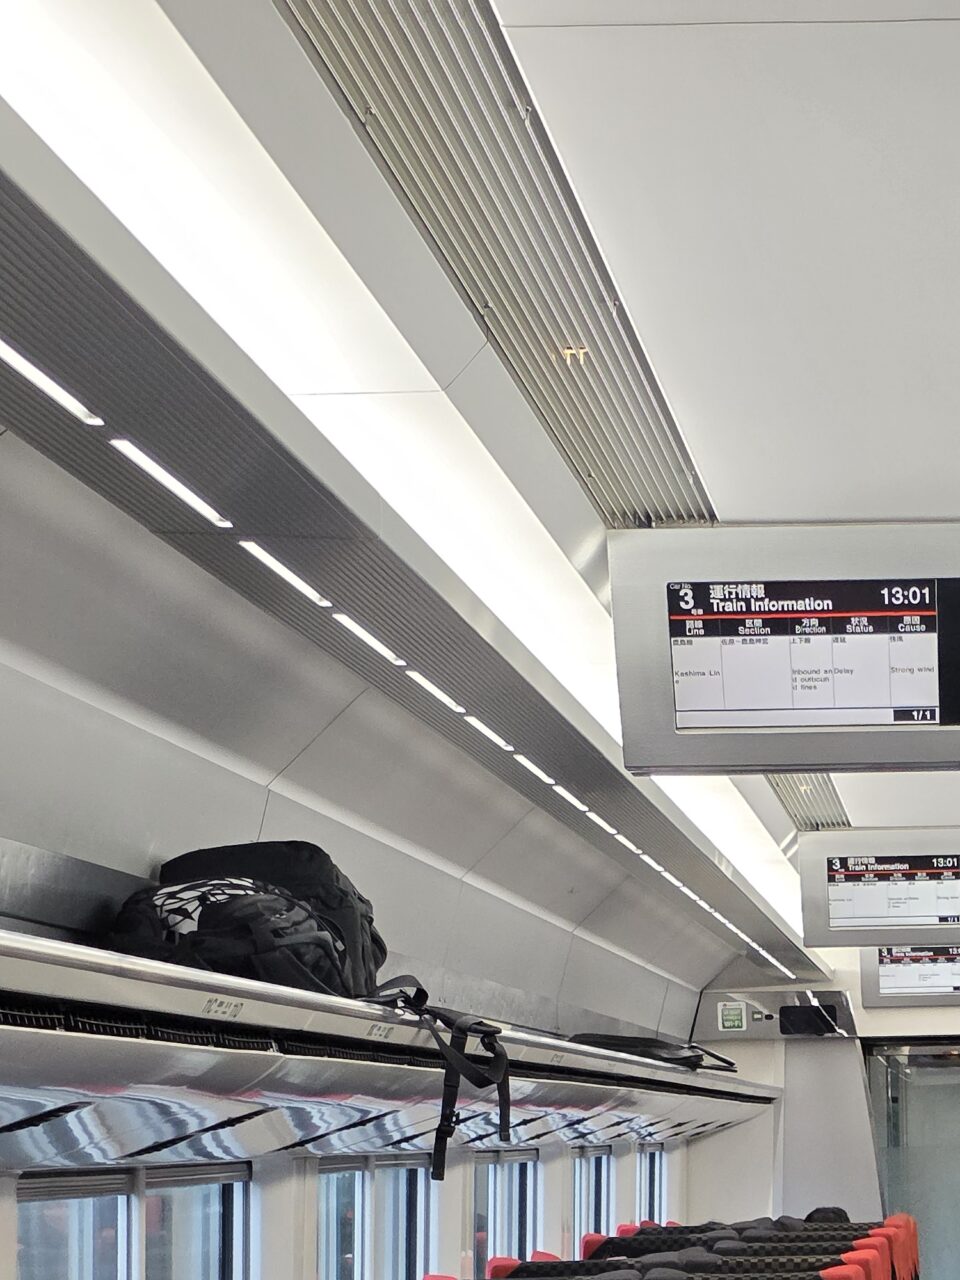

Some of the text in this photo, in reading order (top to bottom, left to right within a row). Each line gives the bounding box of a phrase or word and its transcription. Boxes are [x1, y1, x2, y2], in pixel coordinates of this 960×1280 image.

[709, 584, 765, 599] 運行情報
[880, 587, 929, 604] 13:01
[679, 589, 695, 610] 3
[710, 597, 832, 612] Train Information
[686, 627, 704, 635] Line
[738, 626, 770, 635] Section
[795, 626, 827, 634] Direction
[846, 624, 873, 632] Status
[898, 623, 926, 632] Cause
[890, 666, 915, 674] Strong
[912, 710, 930, 720] 1/1
[832, 859, 841, 870] 3
[932, 858, 958, 868] 13:01
